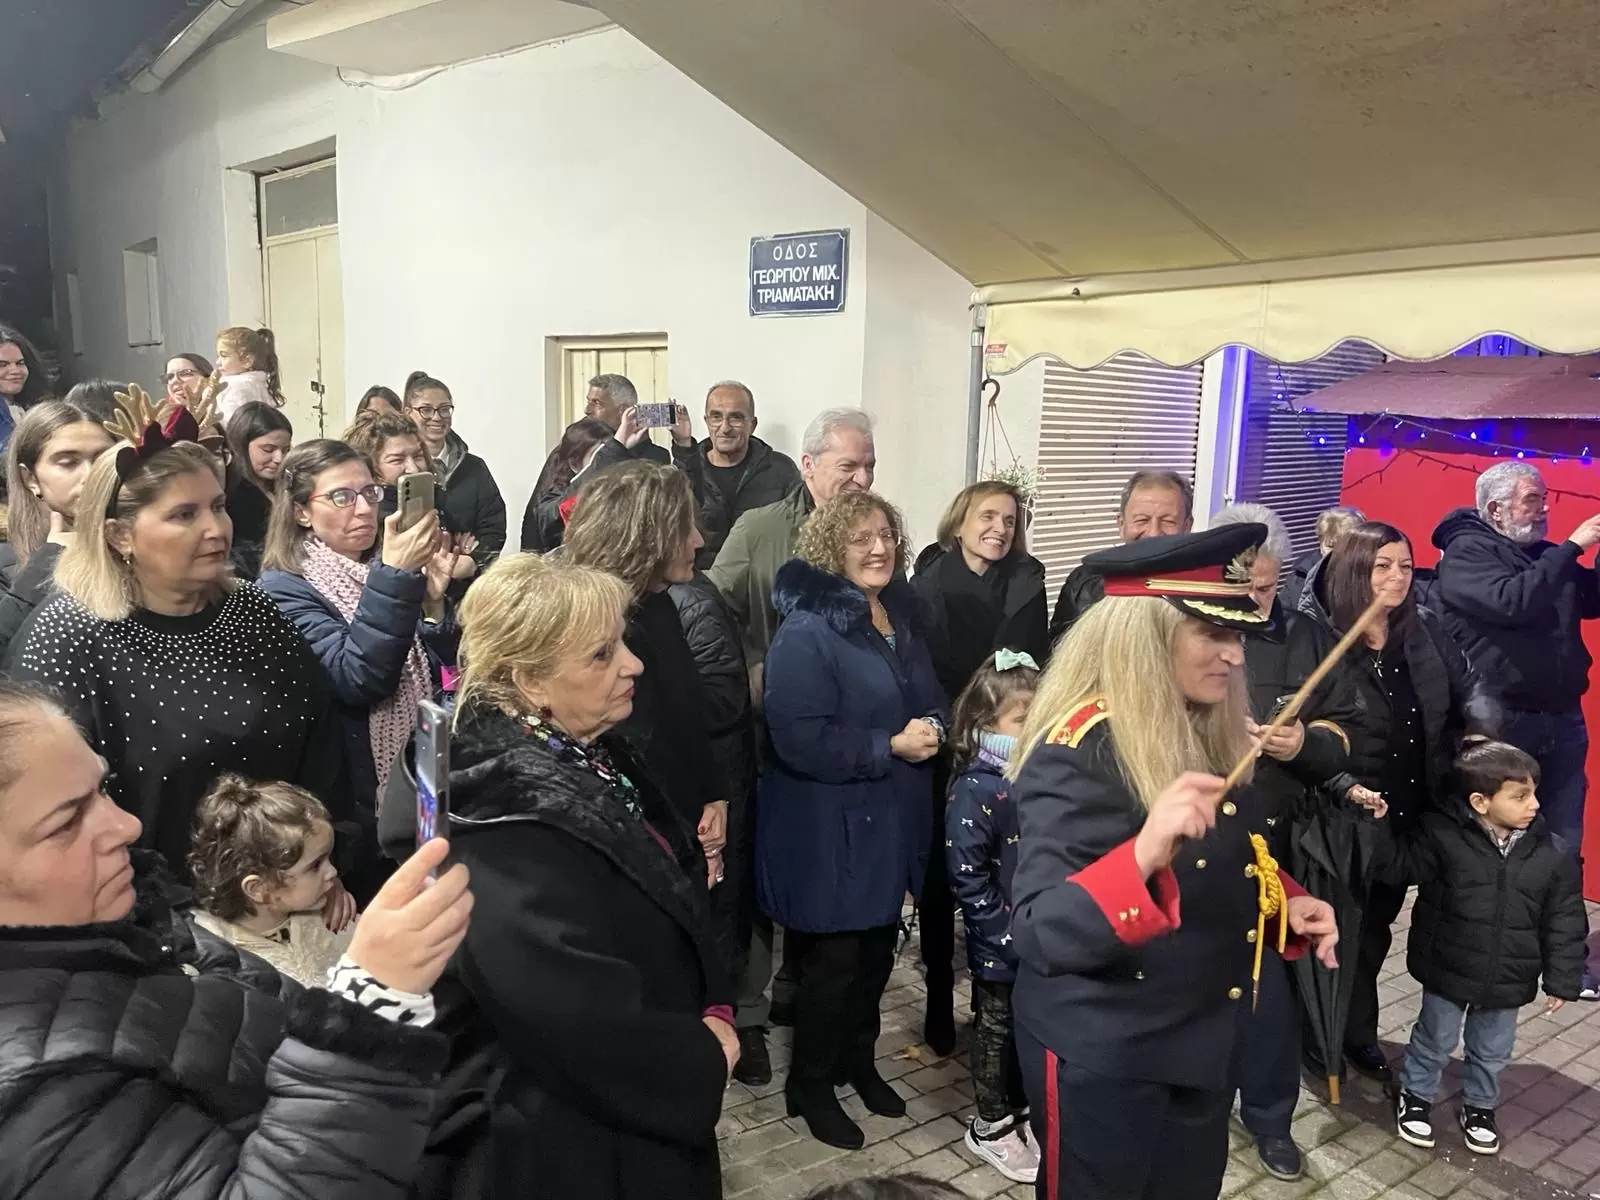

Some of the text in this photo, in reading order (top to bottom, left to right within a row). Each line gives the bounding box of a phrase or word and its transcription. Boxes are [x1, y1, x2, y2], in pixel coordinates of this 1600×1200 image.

[773, 242, 818, 261] ΟΔΟΣ
[753, 264, 840, 285] ΓΕΩΡΓΙΟΥ ΜΙΧ.
[757, 284, 835, 304] ΤΡΙΑΜΑΤΑΚΗ
